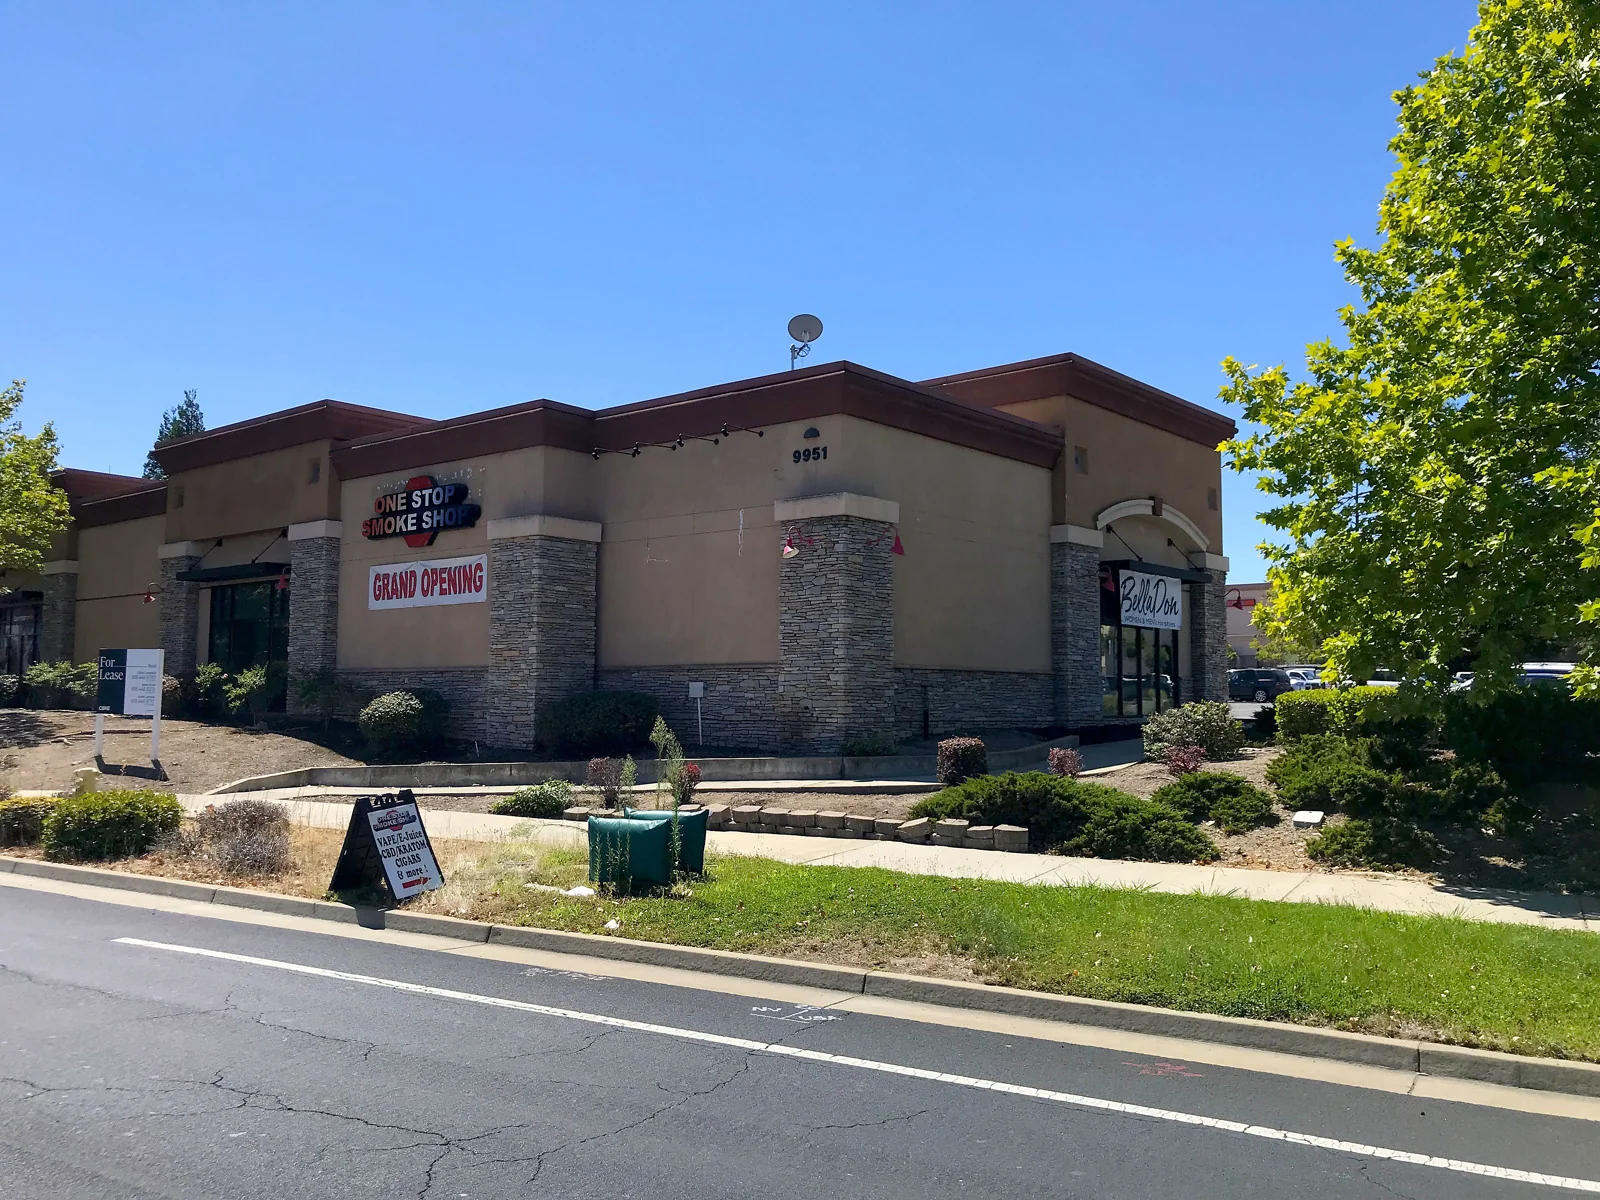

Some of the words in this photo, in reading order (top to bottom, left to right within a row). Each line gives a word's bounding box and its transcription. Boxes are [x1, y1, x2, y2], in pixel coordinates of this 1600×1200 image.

[792, 446, 827, 464] 9951
[374, 493, 407, 514] ONE
[411, 486, 455, 508] STOP
[362, 513, 417, 537] SMOKE
[422, 507, 469, 529] SHOP
[373, 569, 417, 601] GRAND
[421, 563, 483, 597] OPENING
[100, 656, 116, 668] For
[99, 669, 124, 680] Lease
[373, 819, 398, 829] SMOKE
[398, 815, 416, 825] SHO
[377, 830, 423, 847] VAPE/E-Juice
[381, 840, 427, 859] CBD/KRATOM
[395, 853, 421, 868] CIGARS
[397, 870, 403, 880] &
[406, 868, 423, 878] more
